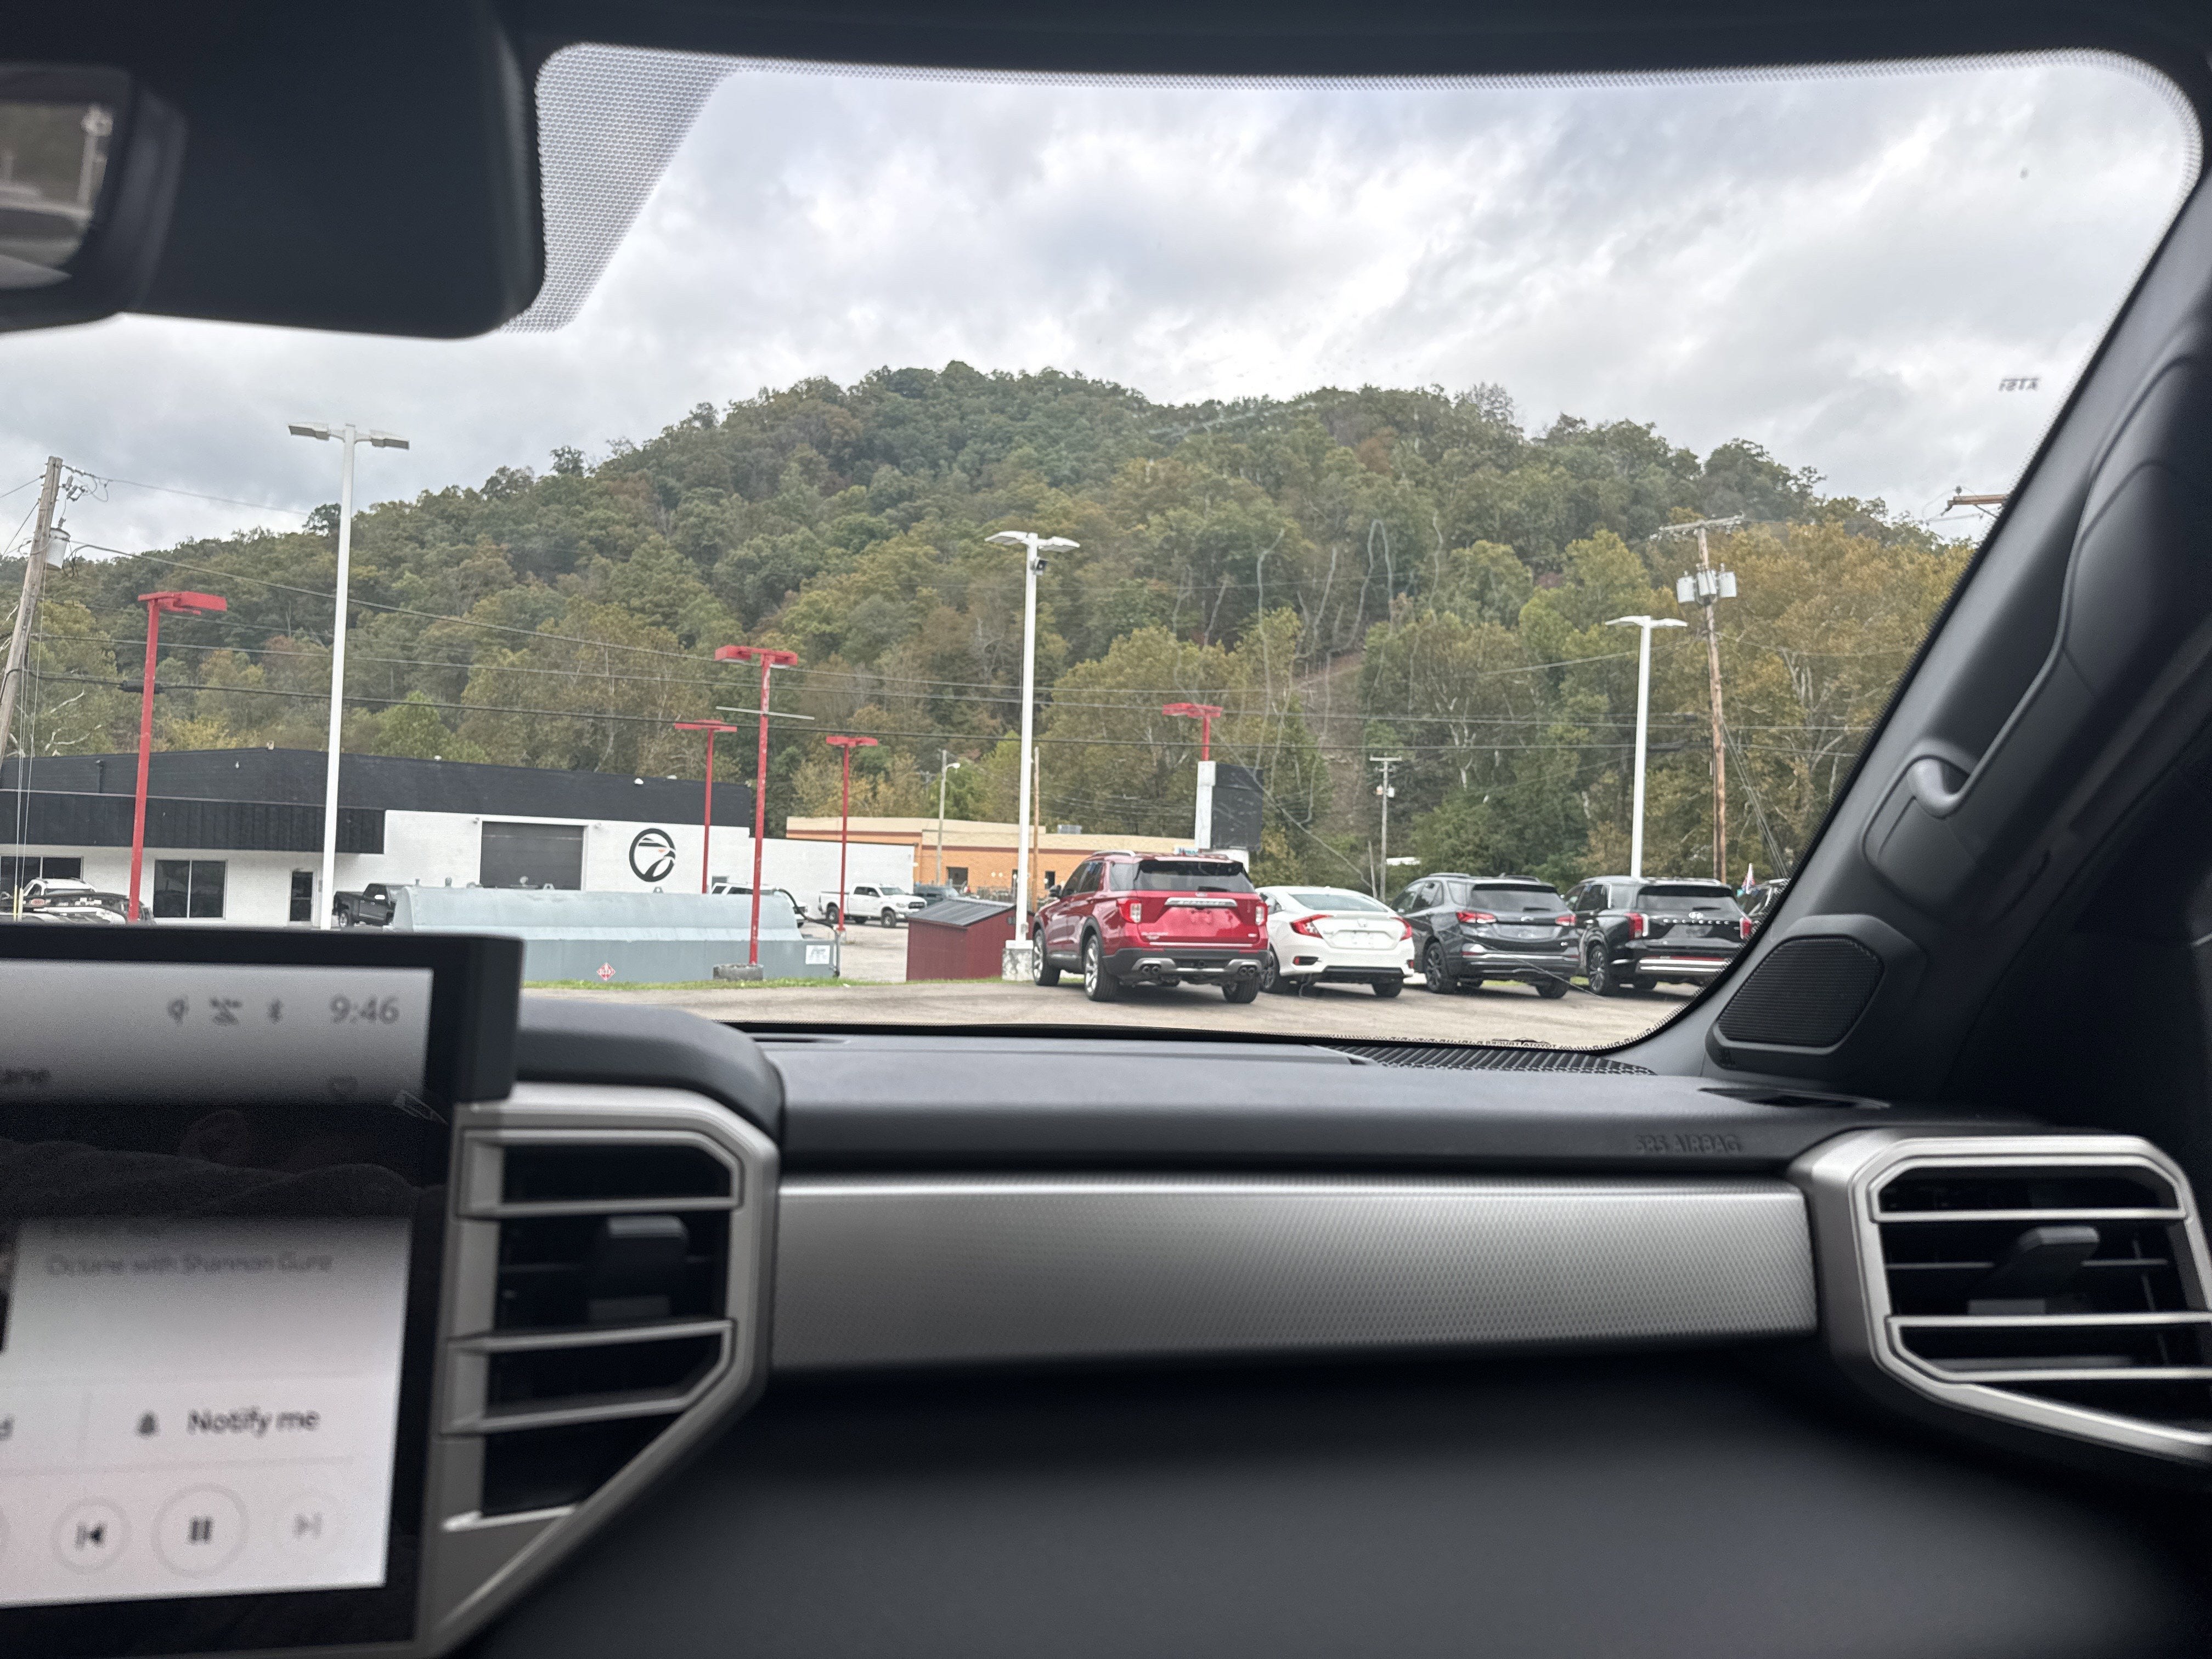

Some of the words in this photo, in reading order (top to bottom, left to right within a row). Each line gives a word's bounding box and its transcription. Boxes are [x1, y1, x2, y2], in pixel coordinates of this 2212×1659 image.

[330, 994, 400, 1025] 9:46
[1635, 1134, 1669, 1153] SRS
[1673, 1134, 1743, 1153] AIRBAG
[187, 1405, 273, 1438] Notify
[276, 1410, 321, 1431] me
